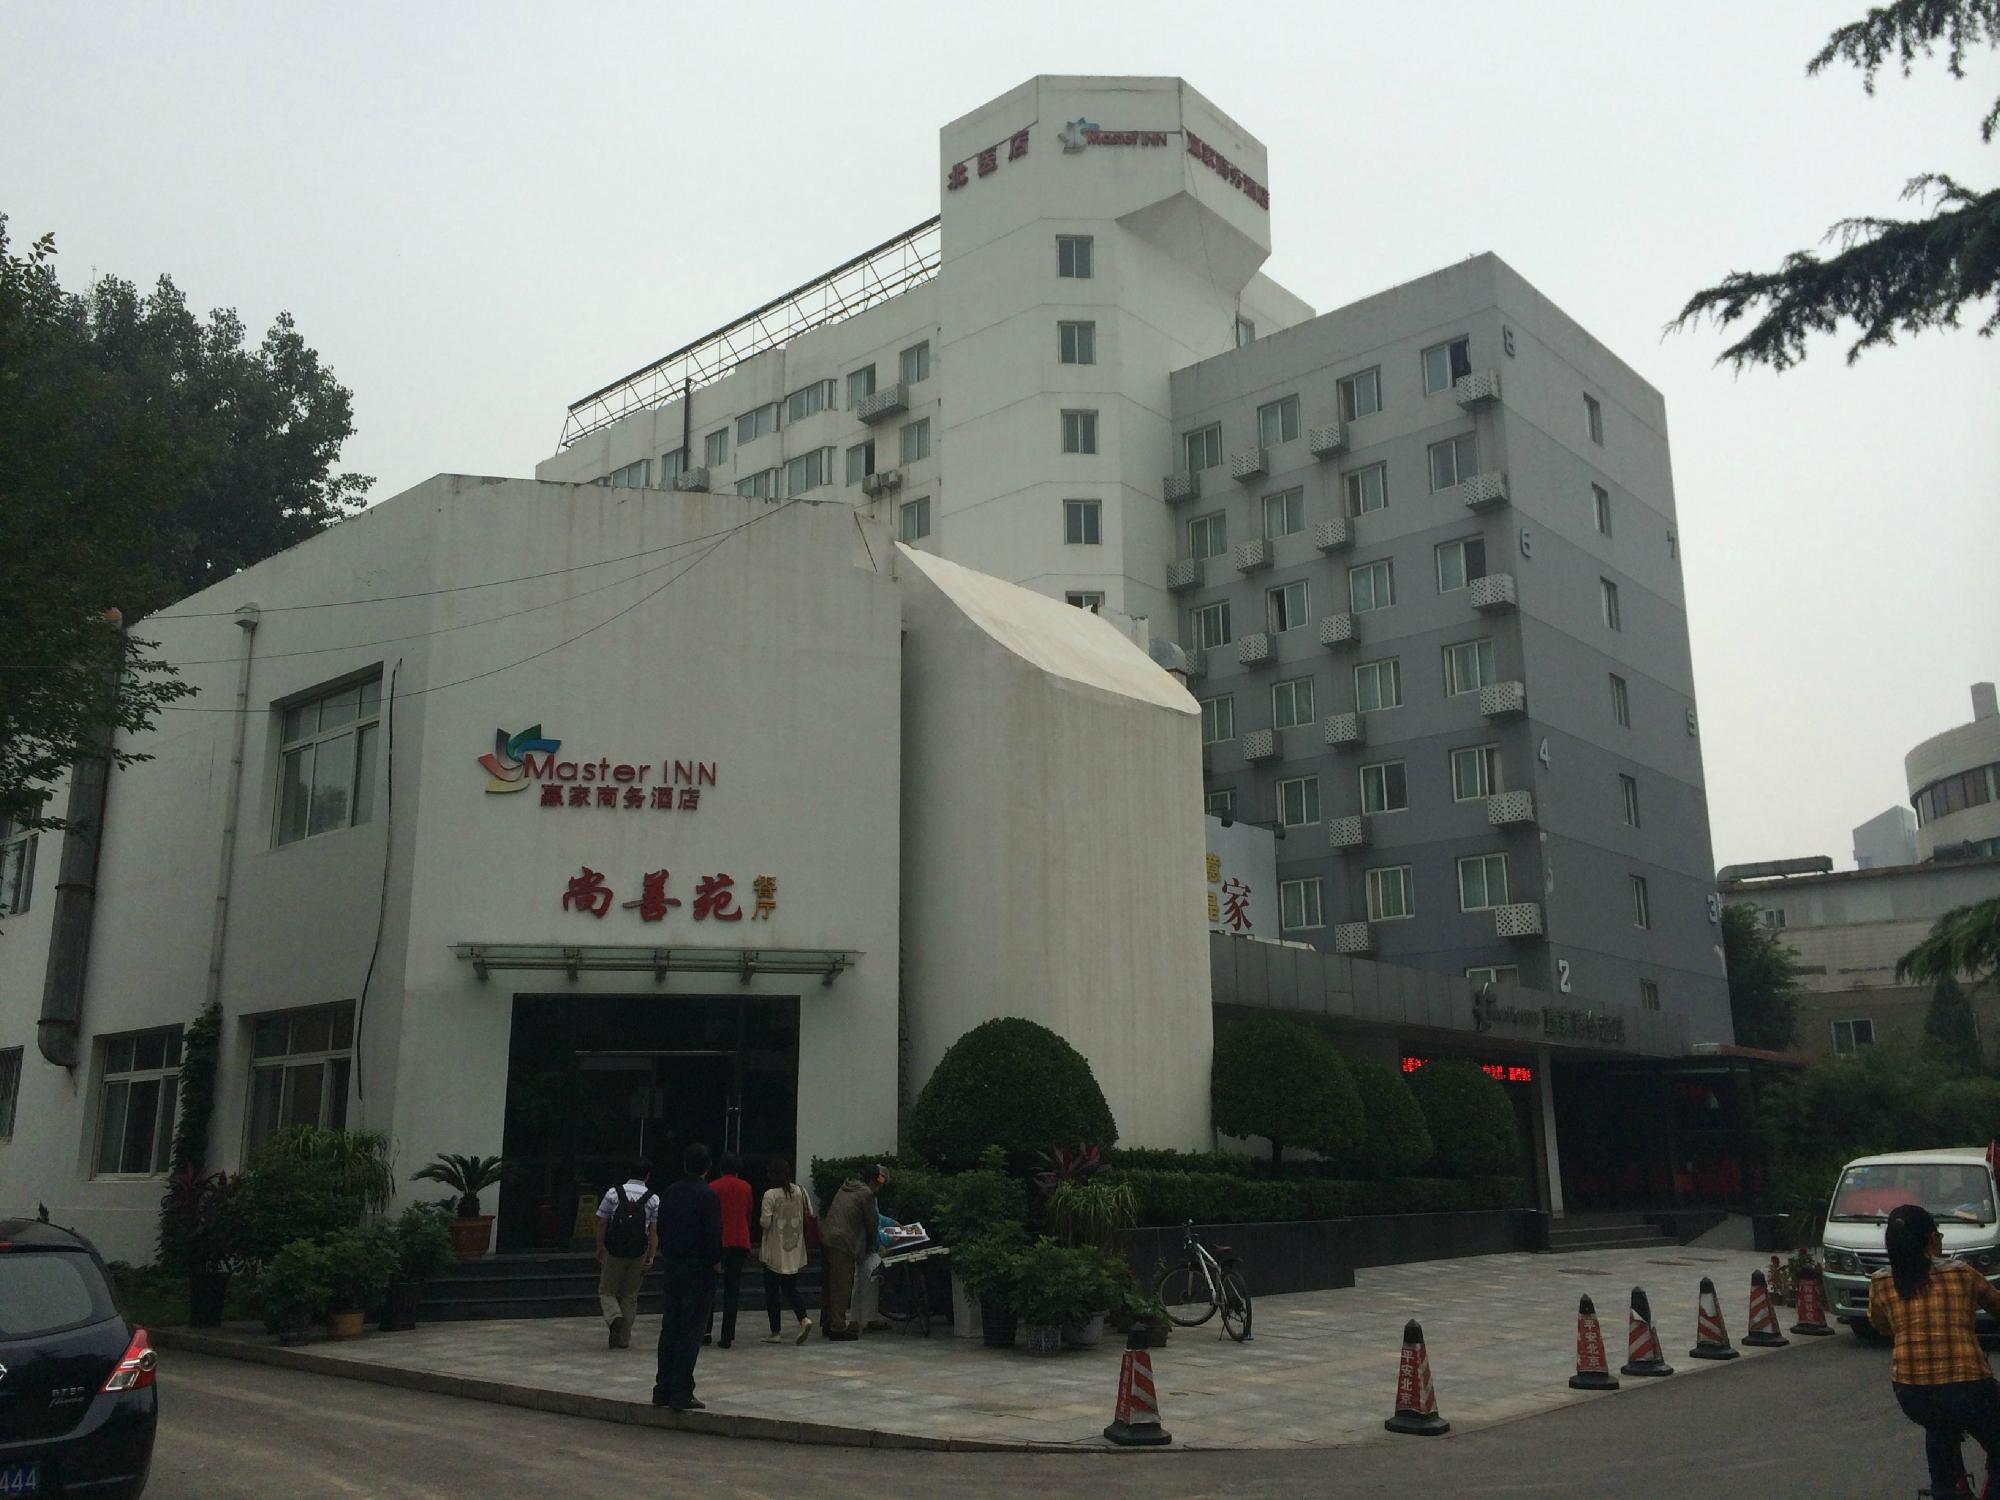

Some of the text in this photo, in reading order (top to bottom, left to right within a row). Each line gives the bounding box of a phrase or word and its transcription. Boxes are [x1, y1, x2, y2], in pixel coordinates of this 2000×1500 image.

[524, 753, 717, 786] Master INN
[1538, 736, 1551, 770] 4
[562, 866, 742, 922] 尚善苑
[752, 874, 777, 920] 餐厅
[1221, 877, 1253, 931] 家
[1558, 958, 1572, 993] 2
[1584, 1319, 1601, 1368] 平安北京
[1399, 1349, 1415, 1405] 平安北京
